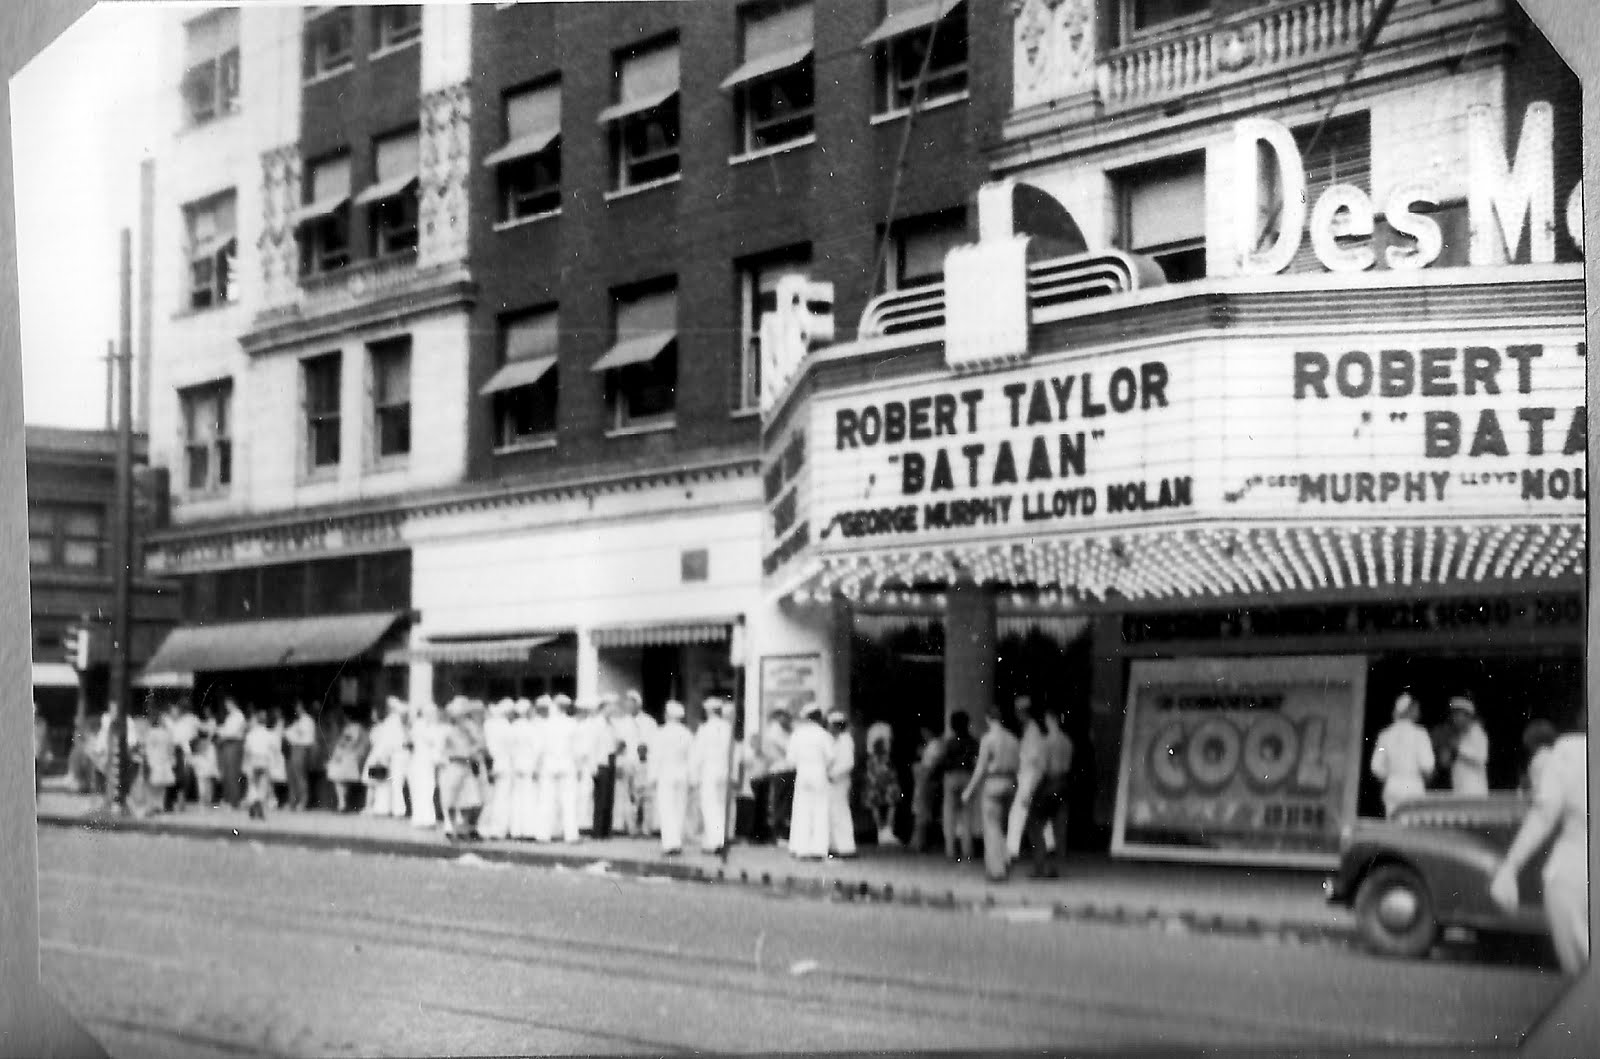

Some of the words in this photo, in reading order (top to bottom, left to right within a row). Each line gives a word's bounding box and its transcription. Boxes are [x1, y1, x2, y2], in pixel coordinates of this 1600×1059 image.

[1232, 117, 1442, 273] Des
[1467, 101, 1584, 267] M
[836, 388, 984, 451] ROBERT
[1003, 361, 1169, 428] TAYLOR
[1293, 343, 1543, 399] ROBERT
[924, 495, 1013, 530] MURPHY
[1023, 487, 1096, 521] LLOYD
[1107, 476, 1192, 513] NOLAN
[1298, 471, 1450, 502] MURPHY
[1144, 712, 1330, 800] COOL
